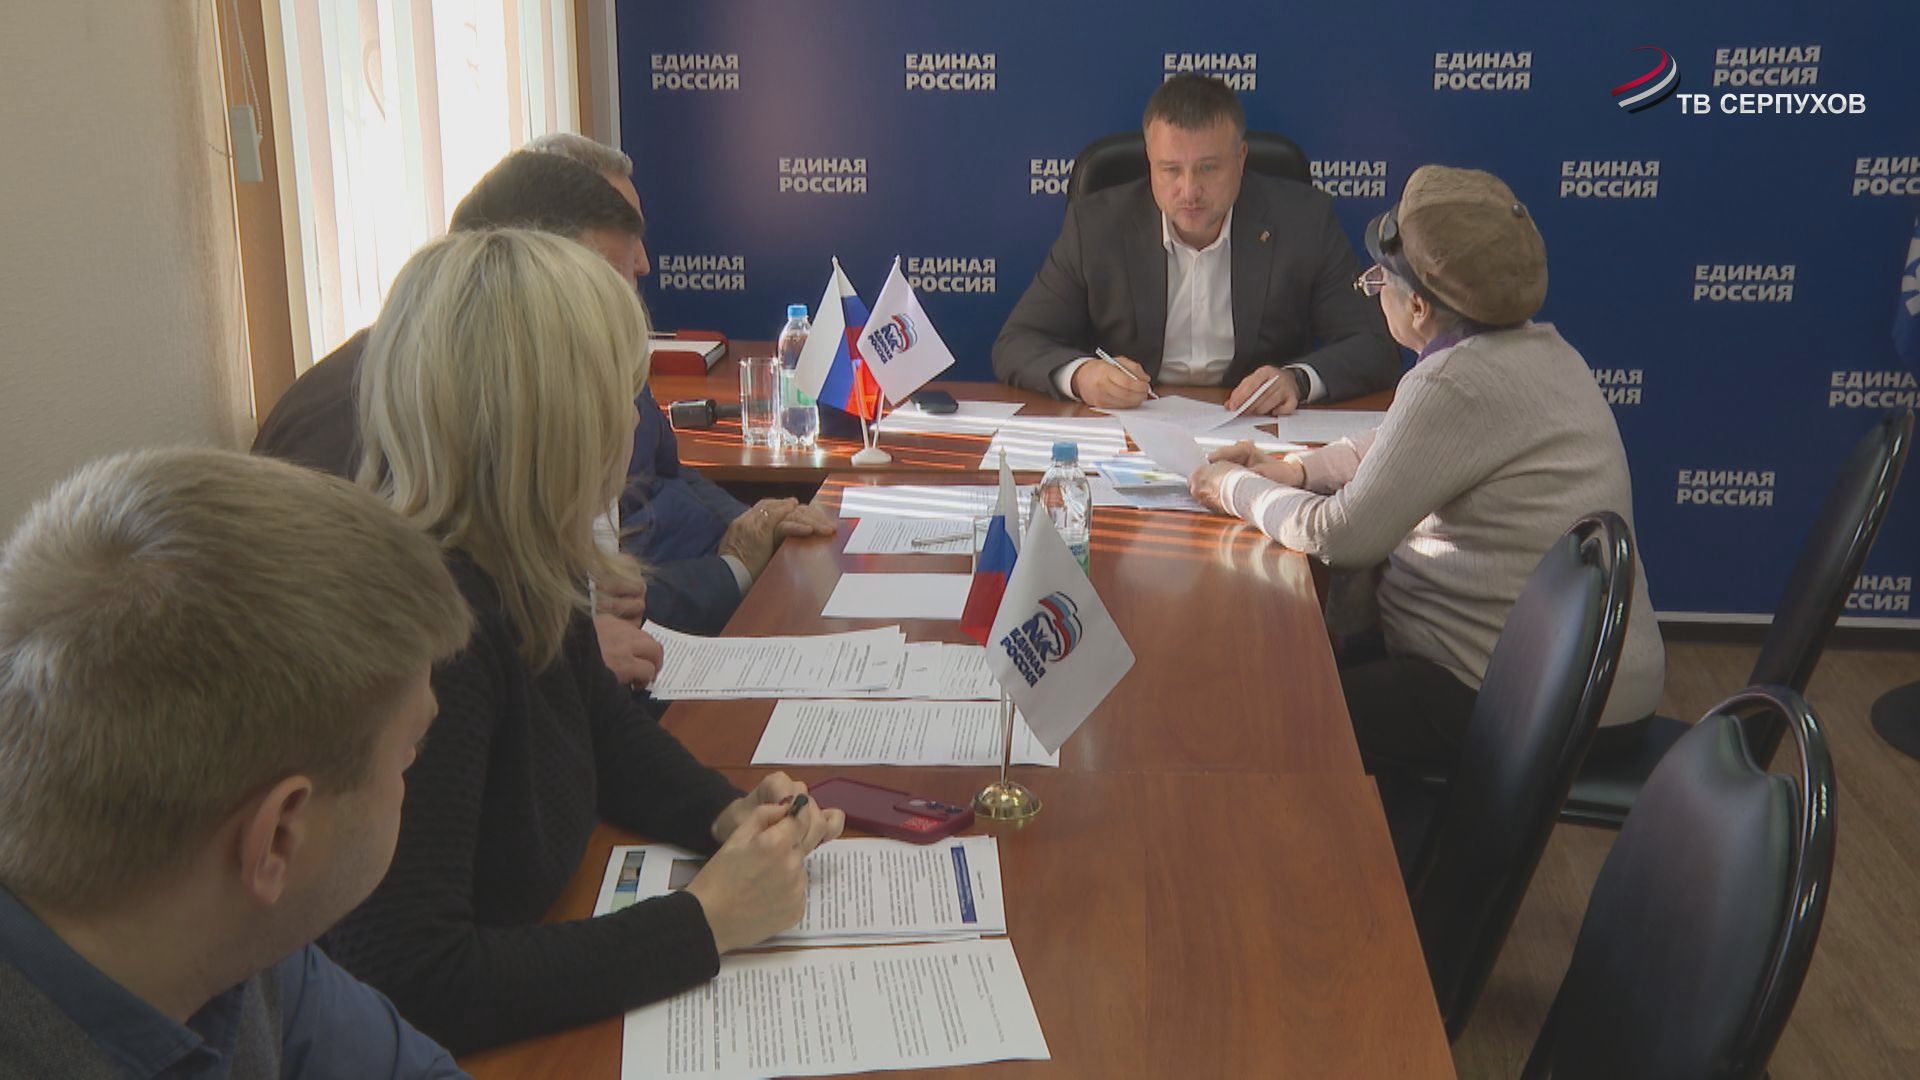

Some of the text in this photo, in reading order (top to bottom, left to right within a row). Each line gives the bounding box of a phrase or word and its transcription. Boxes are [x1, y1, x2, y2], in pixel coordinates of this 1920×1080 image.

[650, 53, 739, 72] ЕДИНАЯ
[905, 53, 996, 72] ЕДИНАЯ
[1164, 53, 1257, 72] ЕДИНАЯ
[1434, 52, 1532, 71] ЕДИНАЯ
[1715, 45, 1821, 67] ЕДИНАЯ
[651, 72, 740, 91] РОССИЯ
[906, 72, 996, 91] РОССИЯ
[1433, 72, 1531, 91] РОССИЯ
[1713, 67, 1818, 87] РОССИЯ
[778, 157, 867, 176] ЕДИНАЯ
[1030, 158, 1076, 177] ЕДИ
[1309, 160, 1387, 178] ДИНАЯ
[1561, 160, 1660, 179] ЕДИНАЯ
[779, 176, 868, 194] РОССИЯ
[1560, 179, 1658, 198] РОССИЯ
[1852, 176, 1920, 197] РОСС
[658, 255, 745, 273] ЕДИНАЯ
[907, 256, 996, 274] ЕДИНАЯ
[1695, 264, 1796, 283] ЕДИНАЯ
[659, 273, 745, 291] РОССИЯ
[907, 275, 996, 293] РОССИЯ
[1693, 283, 1794, 302] РОССИЯ
[1831, 371, 1918, 390] ЕДИНА
[1828, 390, 1920, 408] РОССИ
[1678, 469, 1776, 488] ЕДИНАЯ
[1676, 488, 1774, 507] РОССИЯ
[1844, 592, 1910, 611] ССИЯ
[1000, 636, 1039, 689] РОССИЯ
[1009, 627, 1046, 679] ЕДИНАЯ
